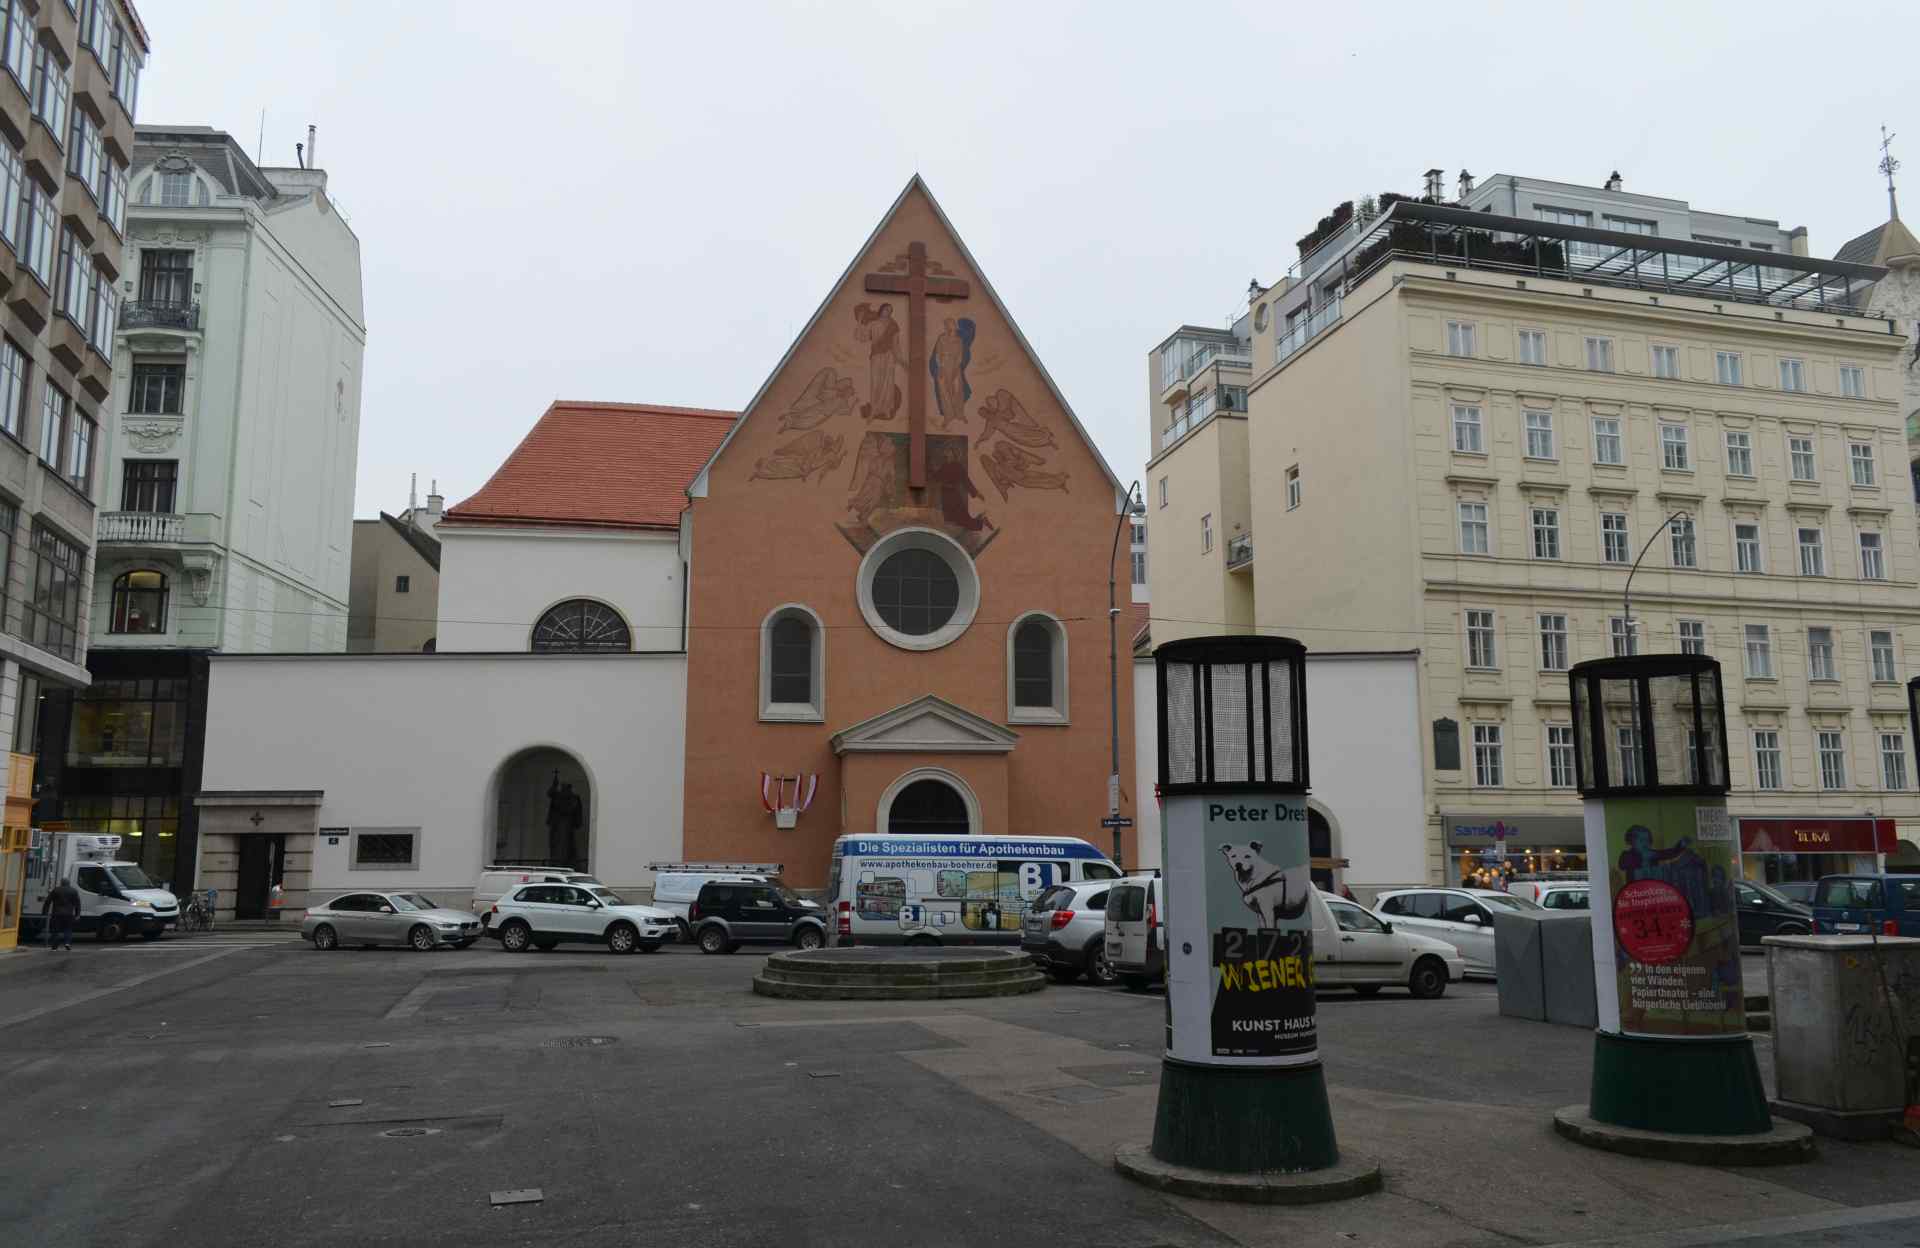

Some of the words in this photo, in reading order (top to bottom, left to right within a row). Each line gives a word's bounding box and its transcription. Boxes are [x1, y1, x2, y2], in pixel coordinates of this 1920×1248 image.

[1209, 804, 1268, 822] Peter
[859, 842, 879, 853] Die
[882, 842, 956, 856] Spezialisten
[959, 842, 976, 854] für
[978, 843, 1065, 856] Apothekenbau
[860, 860, 998, 870] www.apothekenbau-boehrer.de
[1219, 953, 1307, 992] WIENER
[1231, 1019, 1280, 1032] KUNST
[1283, 1016, 1311, 1031] HAUS
